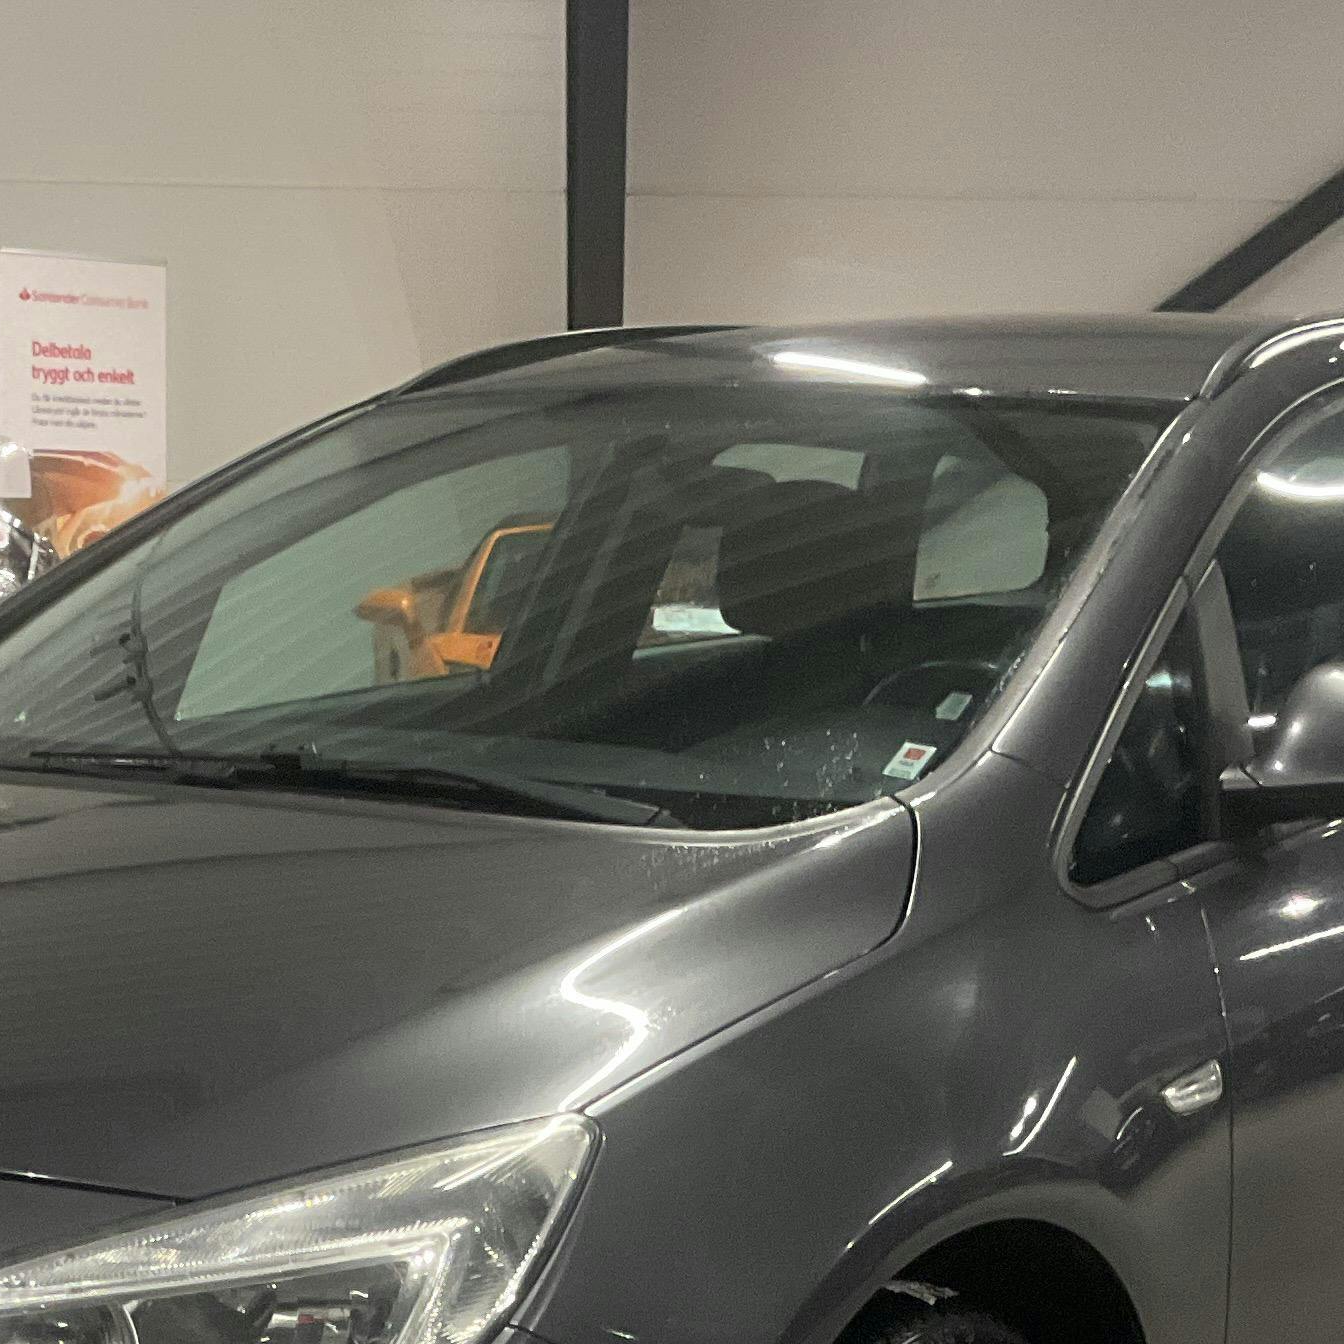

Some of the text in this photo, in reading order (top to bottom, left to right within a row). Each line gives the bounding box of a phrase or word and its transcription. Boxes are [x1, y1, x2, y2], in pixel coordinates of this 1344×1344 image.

[32, 341, 92, 360] Delbetala
[32, 365, 135, 385] tryggt och enkelt
